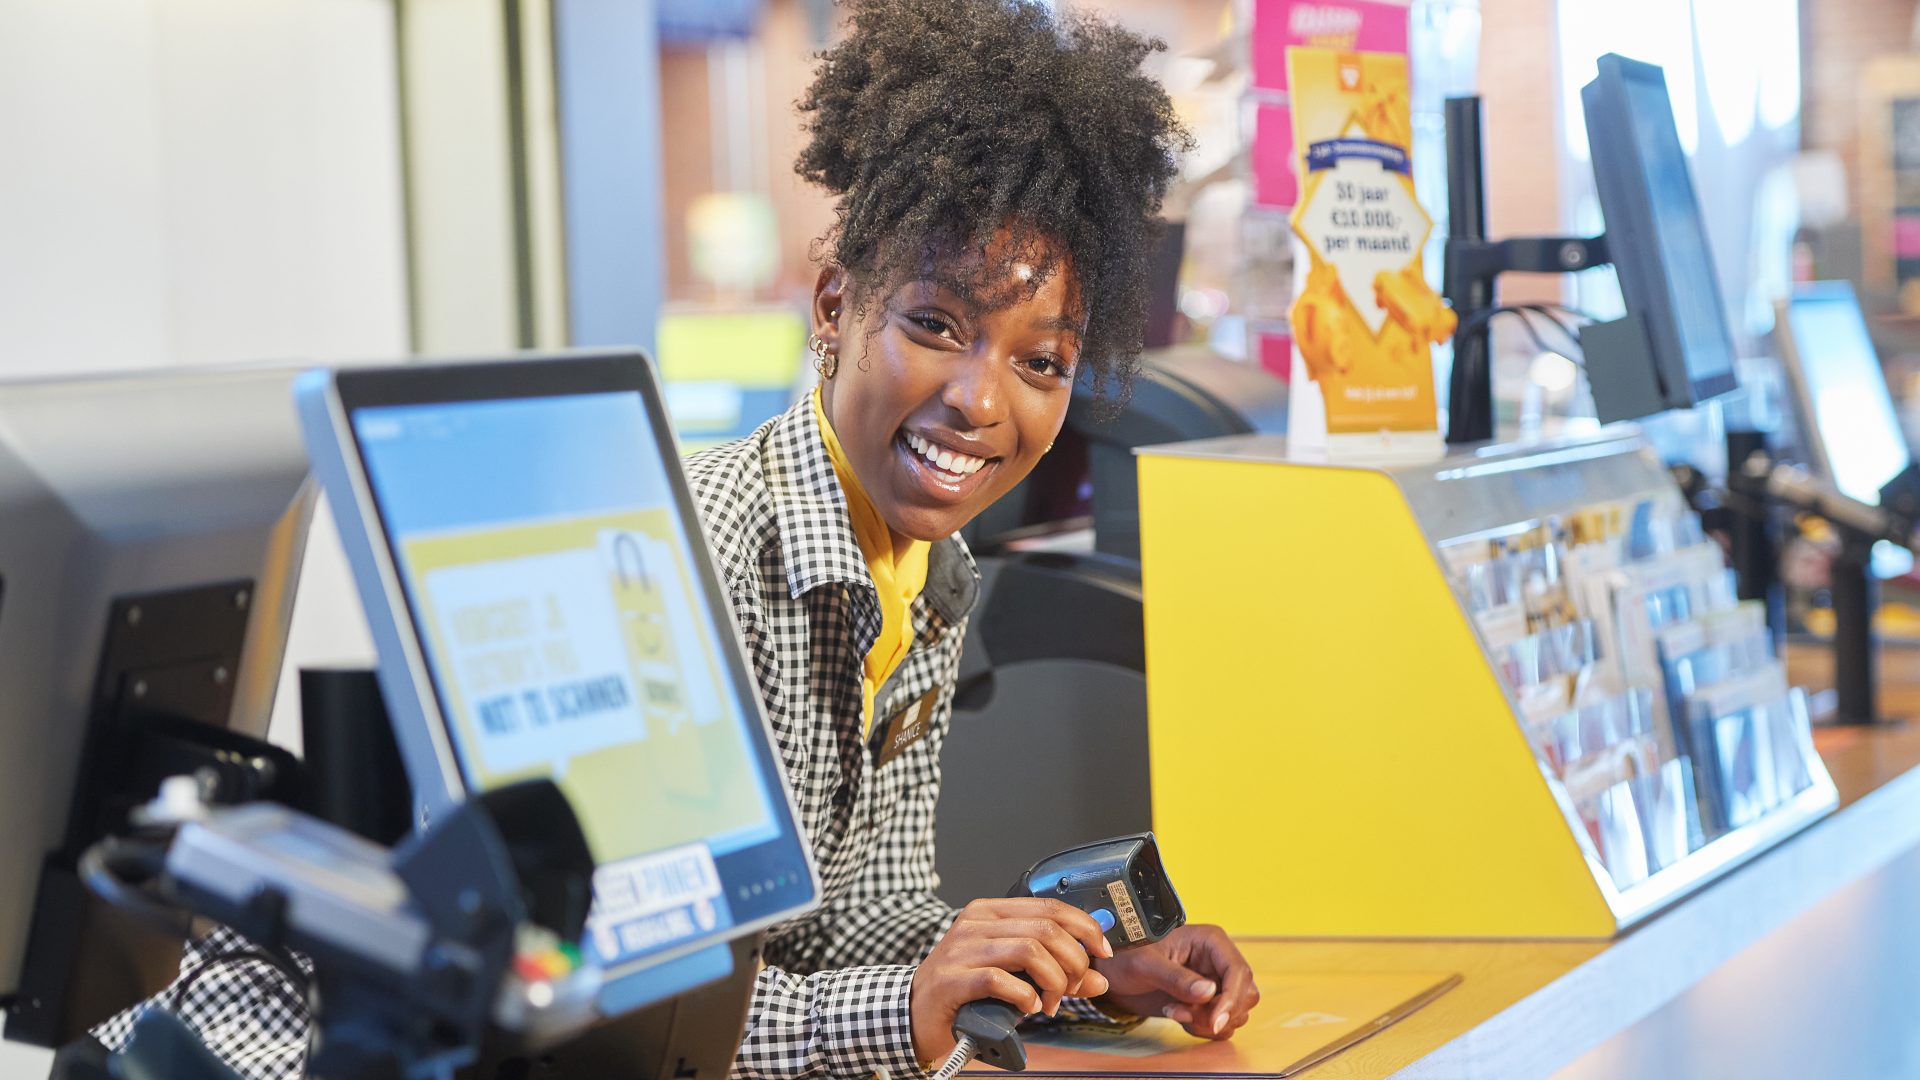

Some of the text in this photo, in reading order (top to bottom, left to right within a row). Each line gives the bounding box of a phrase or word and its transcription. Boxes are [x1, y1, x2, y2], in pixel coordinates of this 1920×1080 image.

[1361, 185, 1389, 204] jaar
[1325, 232, 1410, 252] per maand
[894, 721, 921, 749] SHANICE
